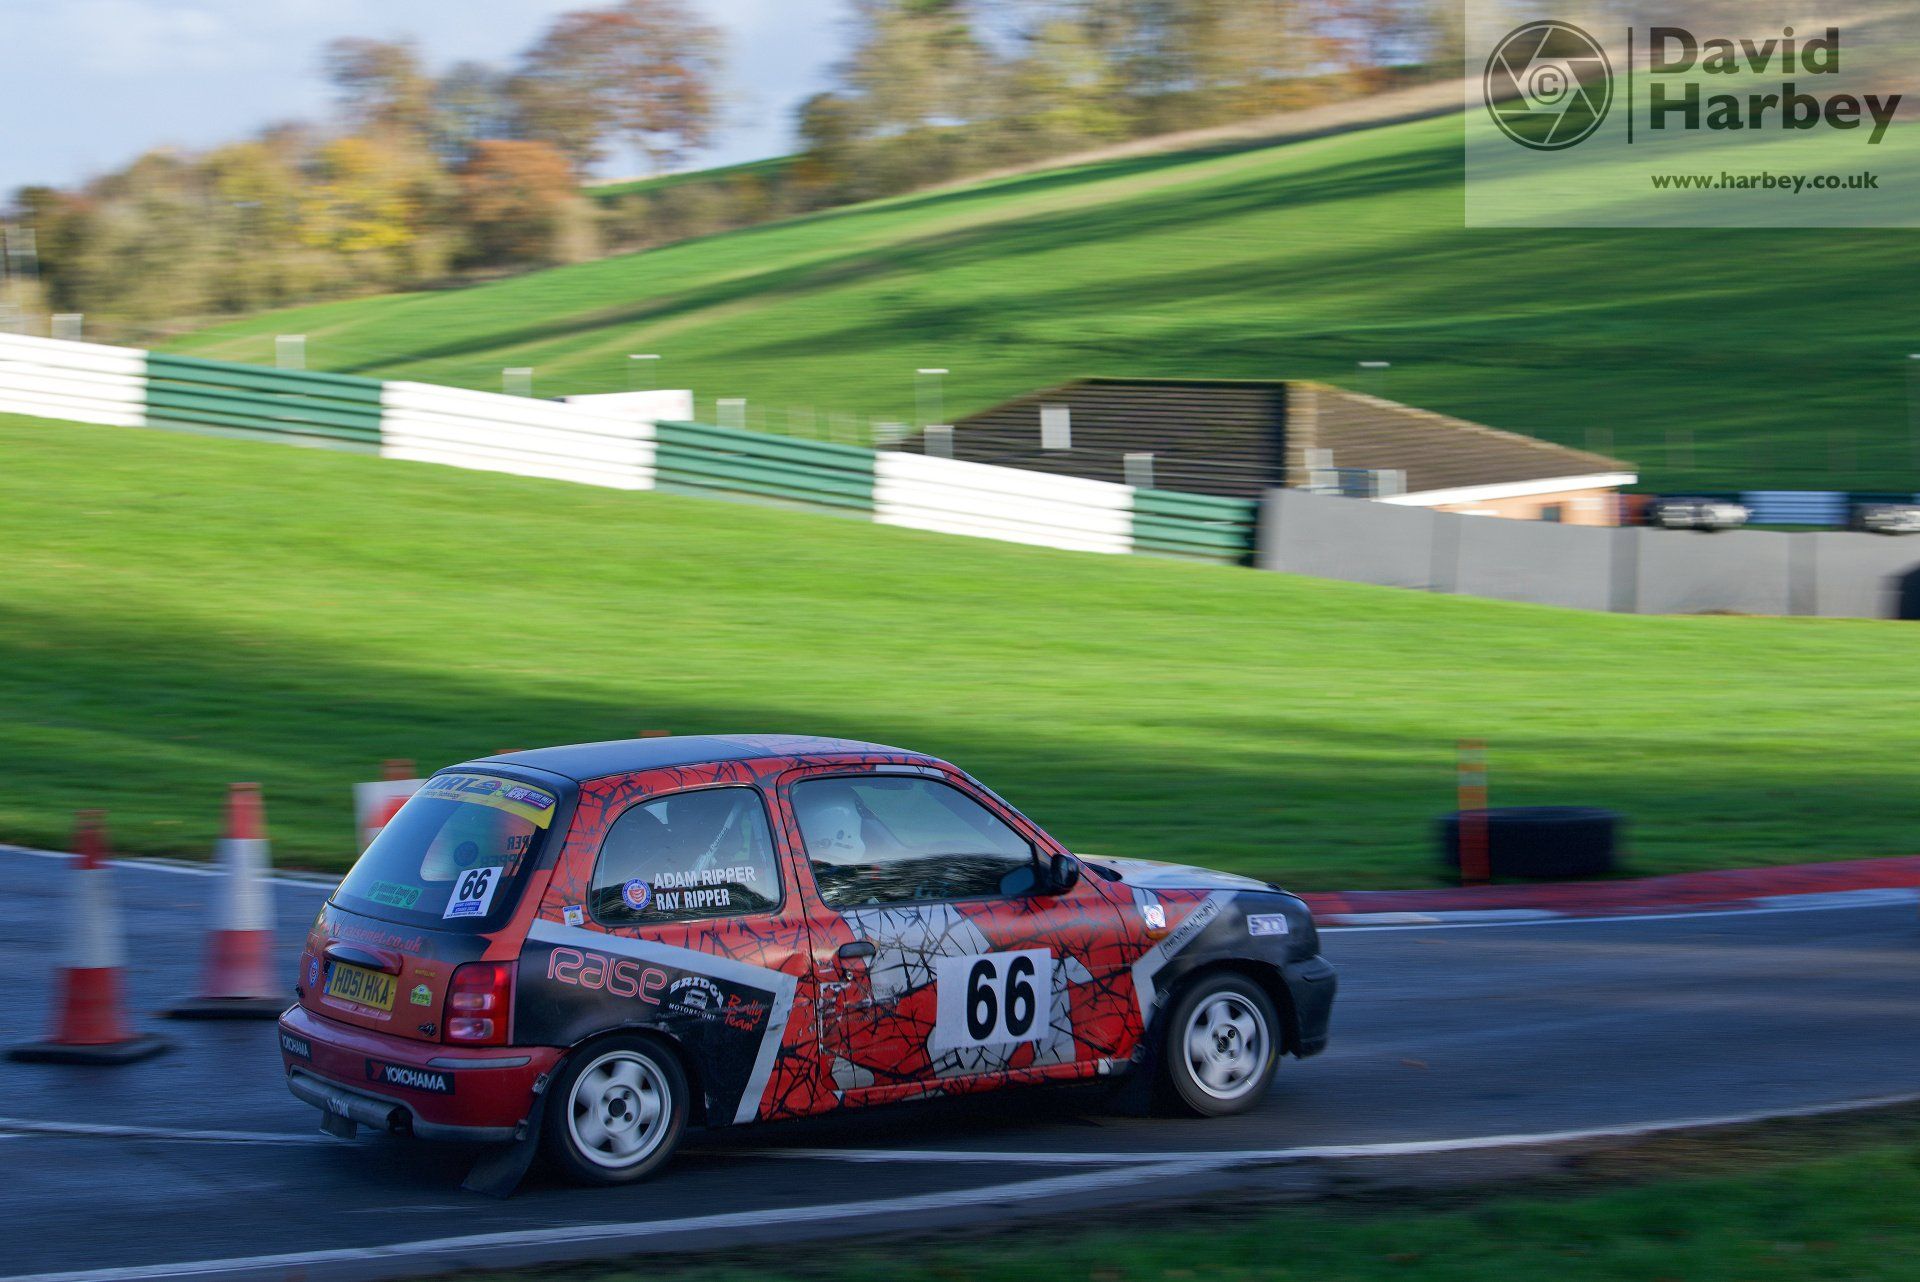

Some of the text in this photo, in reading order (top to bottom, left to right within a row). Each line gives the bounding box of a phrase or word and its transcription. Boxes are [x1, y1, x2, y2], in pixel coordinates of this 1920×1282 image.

[459, 868, 492, 900] 66
[653, 866, 757, 890] ADAM RIPPER
[655, 893, 679, 911] RAY
[683, 889, 731, 909] RIPPER
[333, 966, 362, 998] HD51
[362, 975, 391, 1006] HKA
[669, 976, 724, 1008] BRIDGE
[967, 956, 1035, 1040] 66
[668, 1003, 716, 1021] MOTORSPORT
[724, 1010, 754, 1032] Team
[281, 1034, 309, 1058] YOKOHAMA
[385, 1066, 447, 1091] YOKOHAMA
